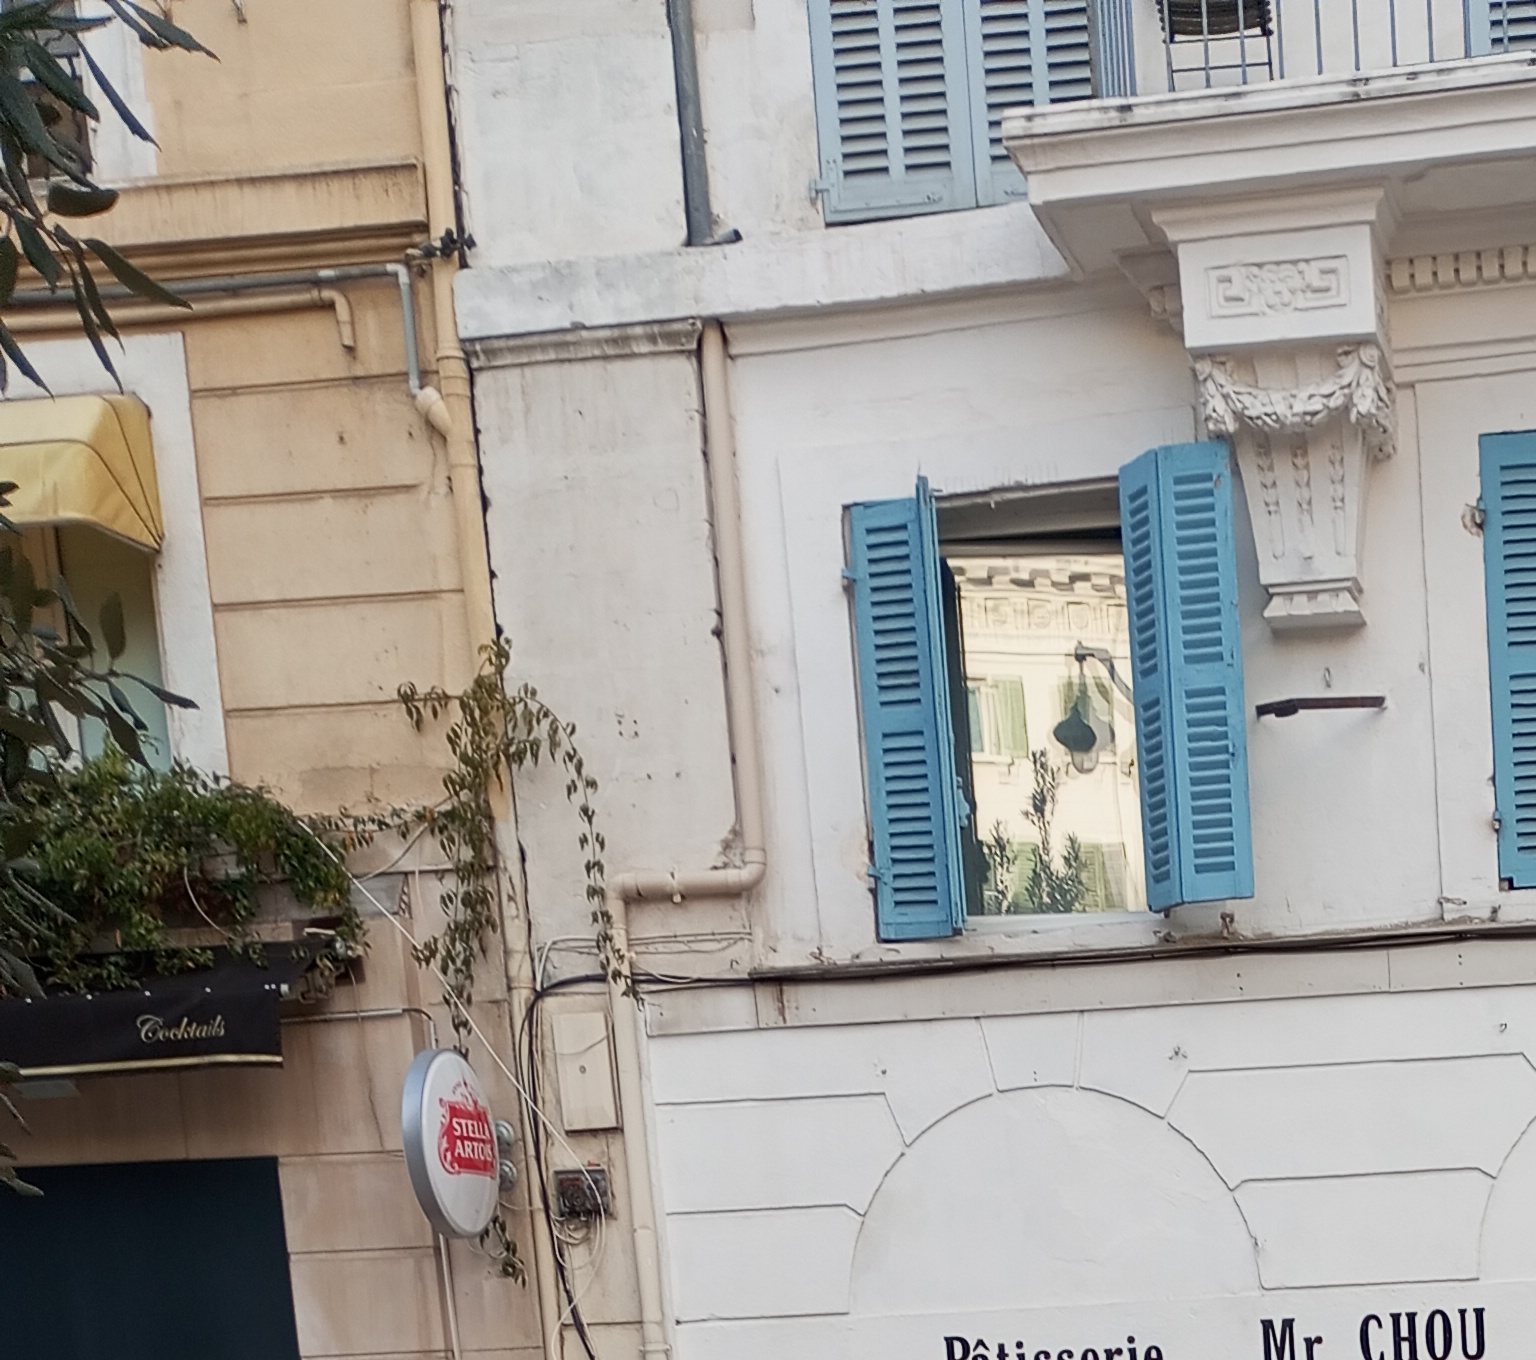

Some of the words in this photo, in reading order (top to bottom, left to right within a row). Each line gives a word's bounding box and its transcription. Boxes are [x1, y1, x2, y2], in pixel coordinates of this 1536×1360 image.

[136, 1014, 225, 1043] Cocktails
[452, 1117, 490, 1139] STELLA
[454, 1139, 493, 1161] ARTOIS
